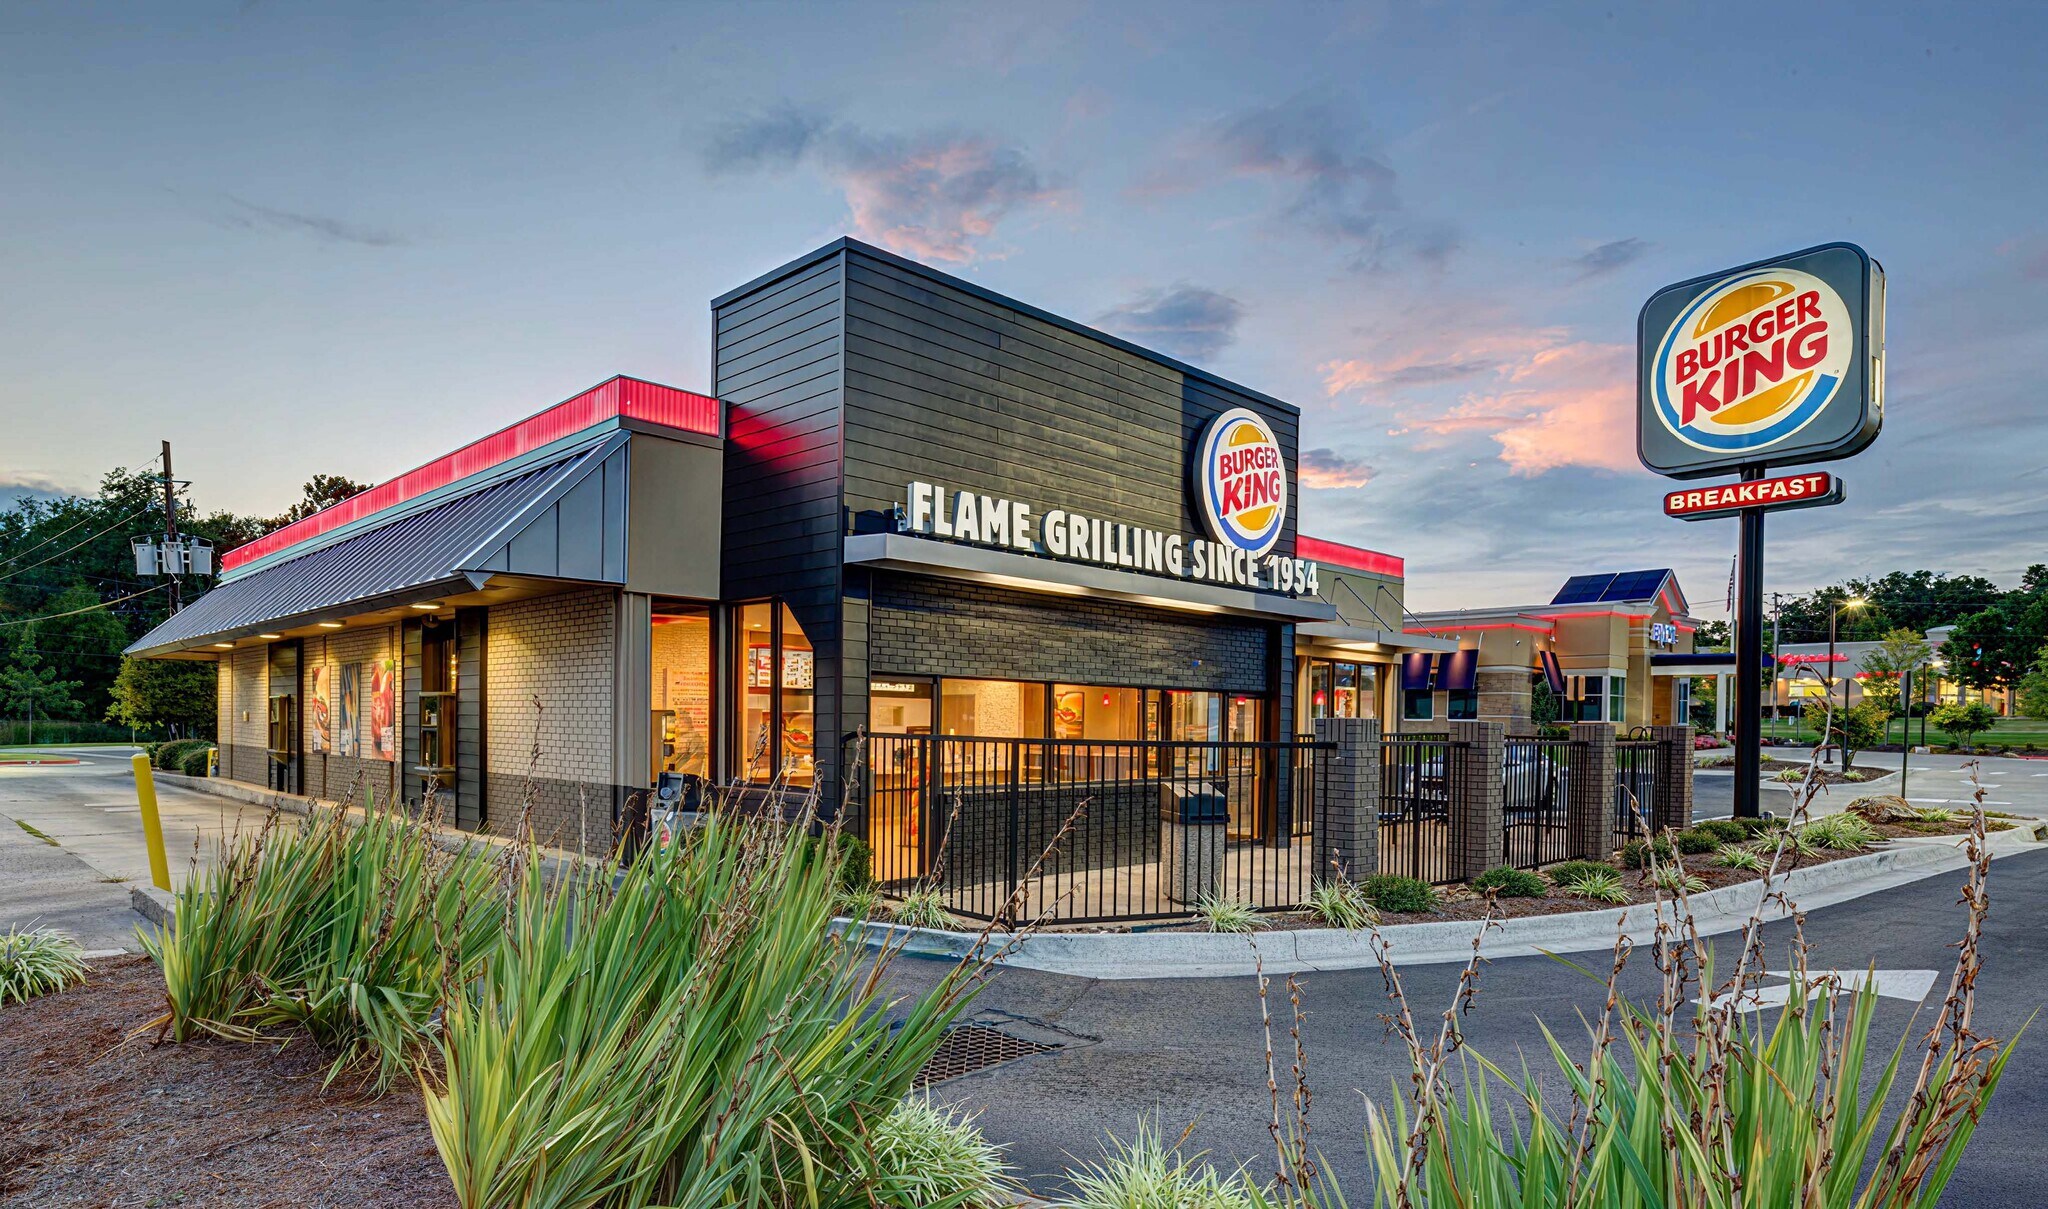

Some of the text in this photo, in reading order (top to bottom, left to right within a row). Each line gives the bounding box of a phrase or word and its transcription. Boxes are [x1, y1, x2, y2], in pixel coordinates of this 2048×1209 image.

[1676, 290, 1821, 385] BURGER
[1681, 320, 1828, 425] KING
[1219, 446, 1279, 481] BURGER
[1221, 470, 1280, 517] KING
[1669, 476, 1822, 510] BREAKFAST
[908, 481, 1319, 596] FLAME GRILLING SINCE 1954
